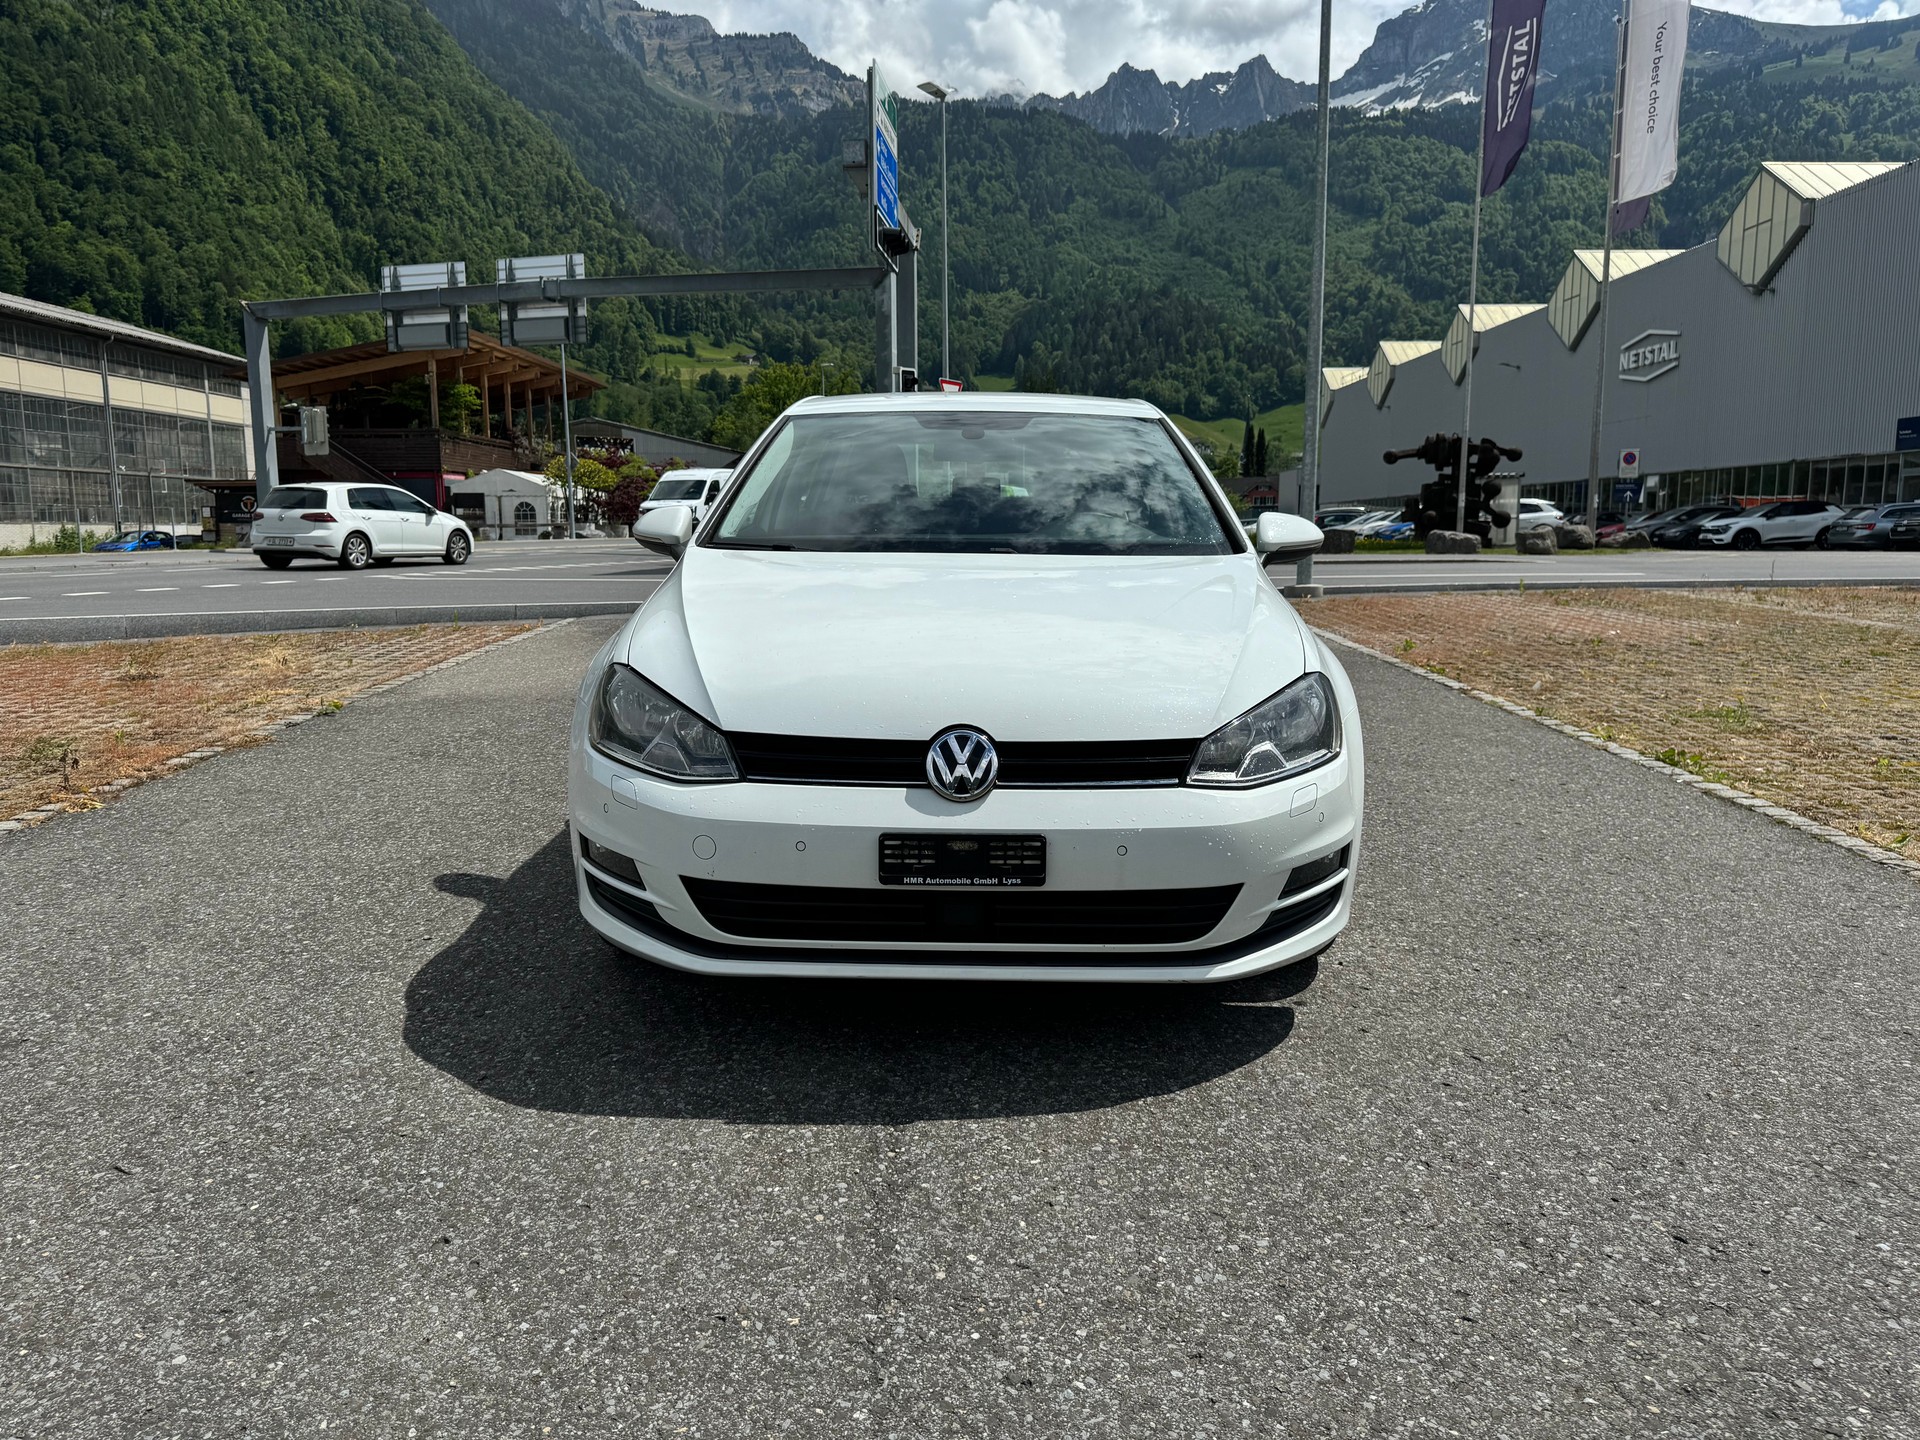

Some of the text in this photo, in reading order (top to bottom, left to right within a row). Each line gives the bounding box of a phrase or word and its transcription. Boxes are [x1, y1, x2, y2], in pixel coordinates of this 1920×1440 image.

[1646, 20, 1668, 134] Your best choice
[1619, 340, 1680, 371] NETSTAL
[925, 877, 971, 885] Automobile
[973, 877, 998, 885] GmbH
[1003, 877, 1021, 885] Lyss
